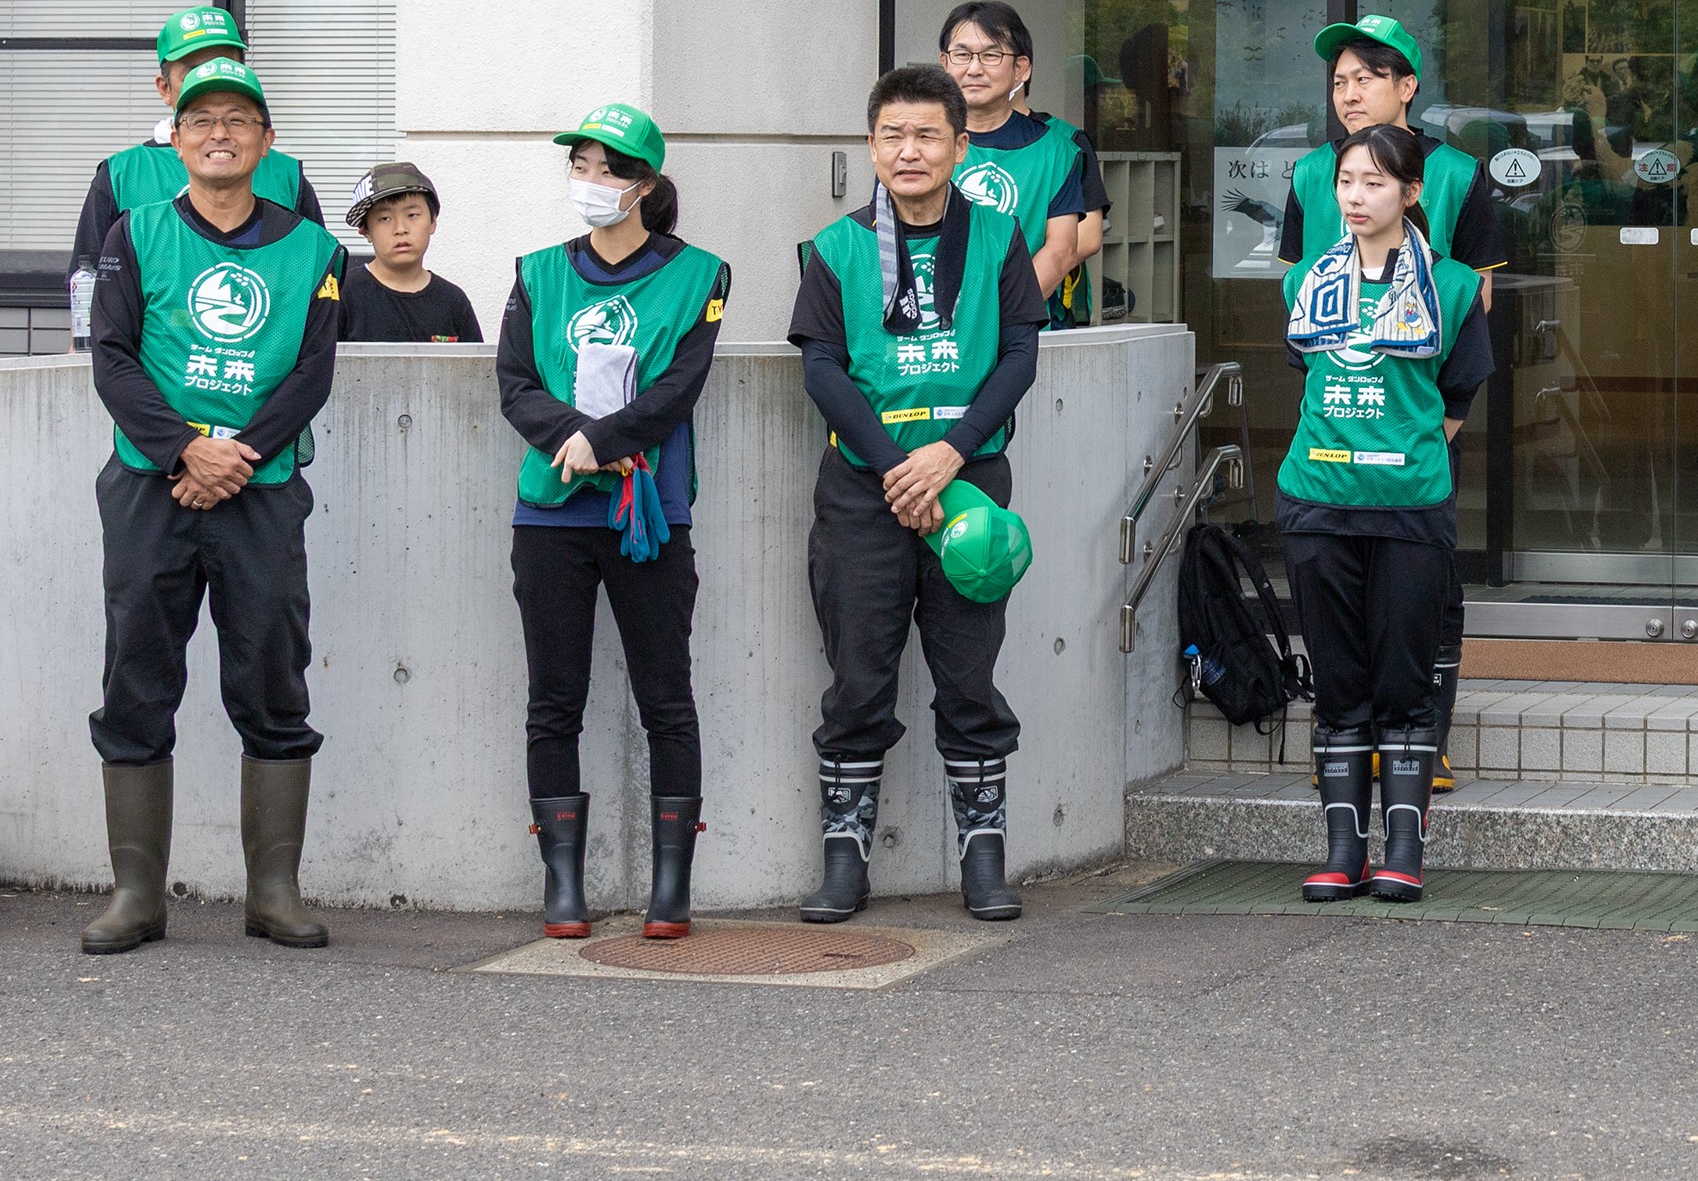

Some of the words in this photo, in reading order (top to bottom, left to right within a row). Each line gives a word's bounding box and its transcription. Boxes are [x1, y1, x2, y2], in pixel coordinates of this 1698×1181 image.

[1228, 160, 1269, 179] 次は
[897, 339, 959, 363] 未来
[186, 354, 255, 382] 未来
[898, 361, 960, 376] プロジェクト
[184, 375, 253, 396] プロジェクト
[1323, 384, 1385, 406] 未来
[893, 411, 927, 419] DUNLOP
[1323, 406, 1384, 419] プロジェクト
